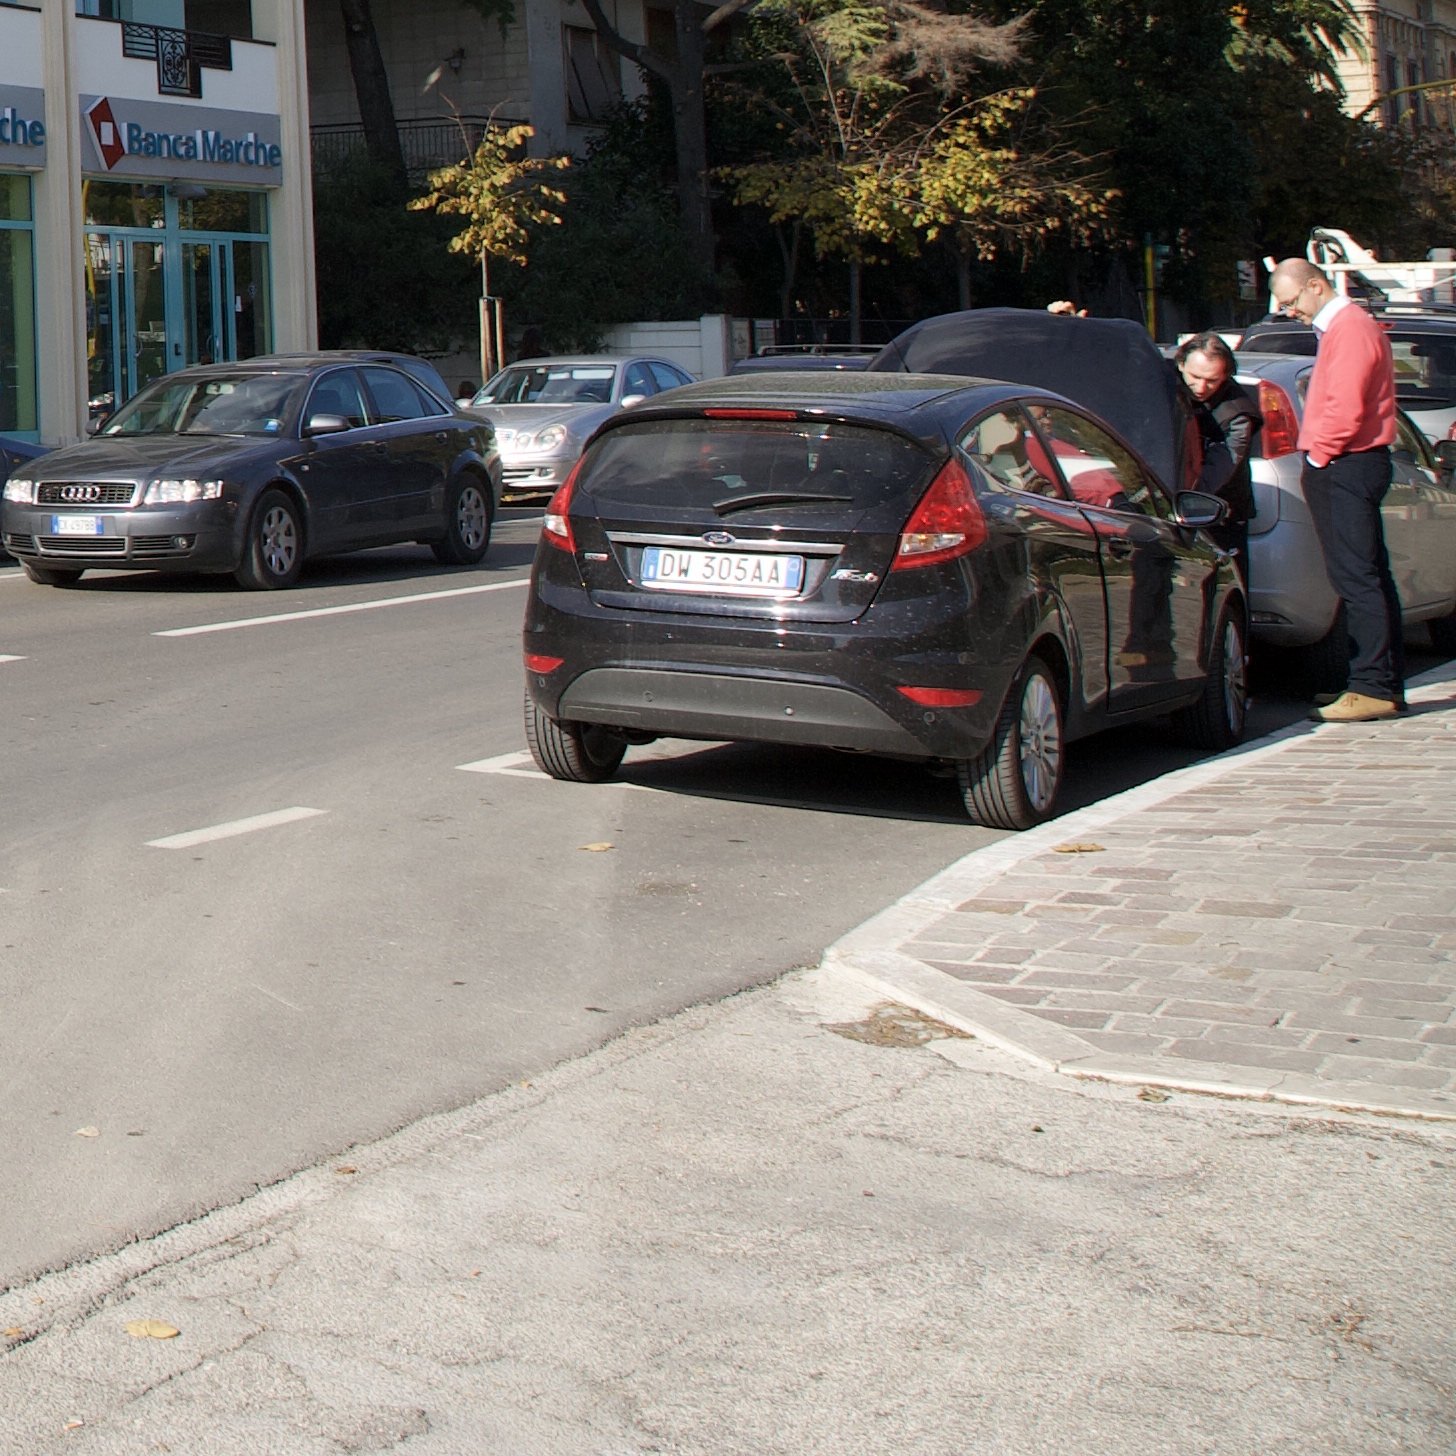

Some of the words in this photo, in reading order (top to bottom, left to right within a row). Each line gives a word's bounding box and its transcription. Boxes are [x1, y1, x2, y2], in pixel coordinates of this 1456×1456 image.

[124, 122, 197, 160] Banca
[199, 129, 282, 167] Marche
[660, 553, 691, 578] DW
[703, 555, 781, 585] 305AA
